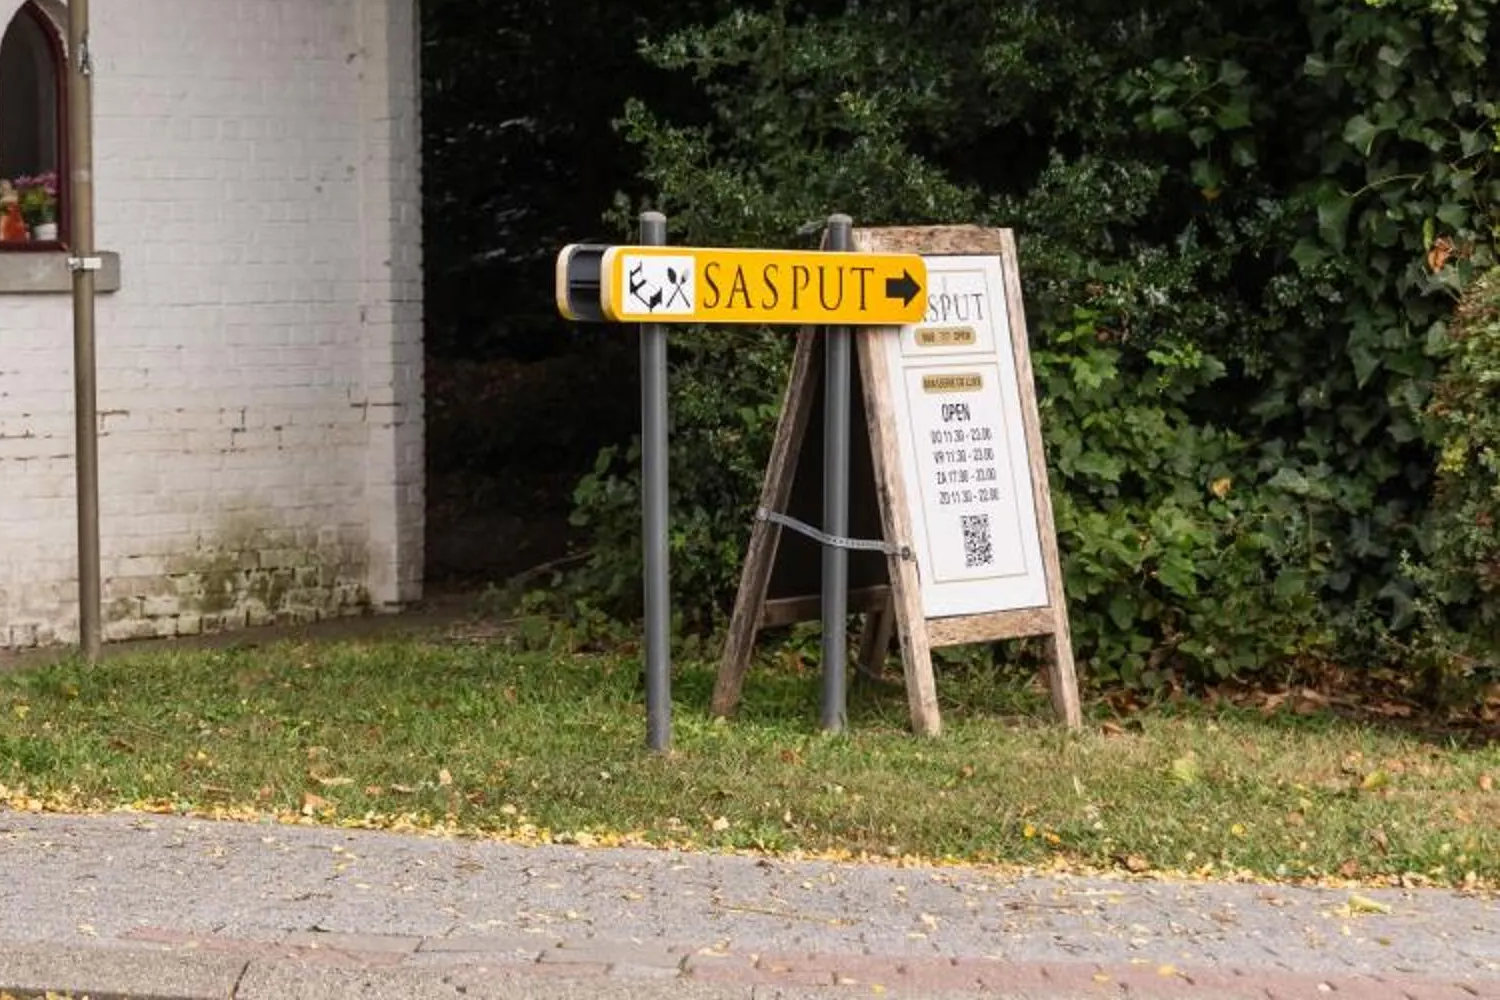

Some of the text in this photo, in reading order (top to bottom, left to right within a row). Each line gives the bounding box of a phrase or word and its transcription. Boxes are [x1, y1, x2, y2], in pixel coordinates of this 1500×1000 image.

[703, 261, 875, 311] SASPUT
[924, 292, 984, 322] SPUT
[941, 403, 971, 422] OPEN
